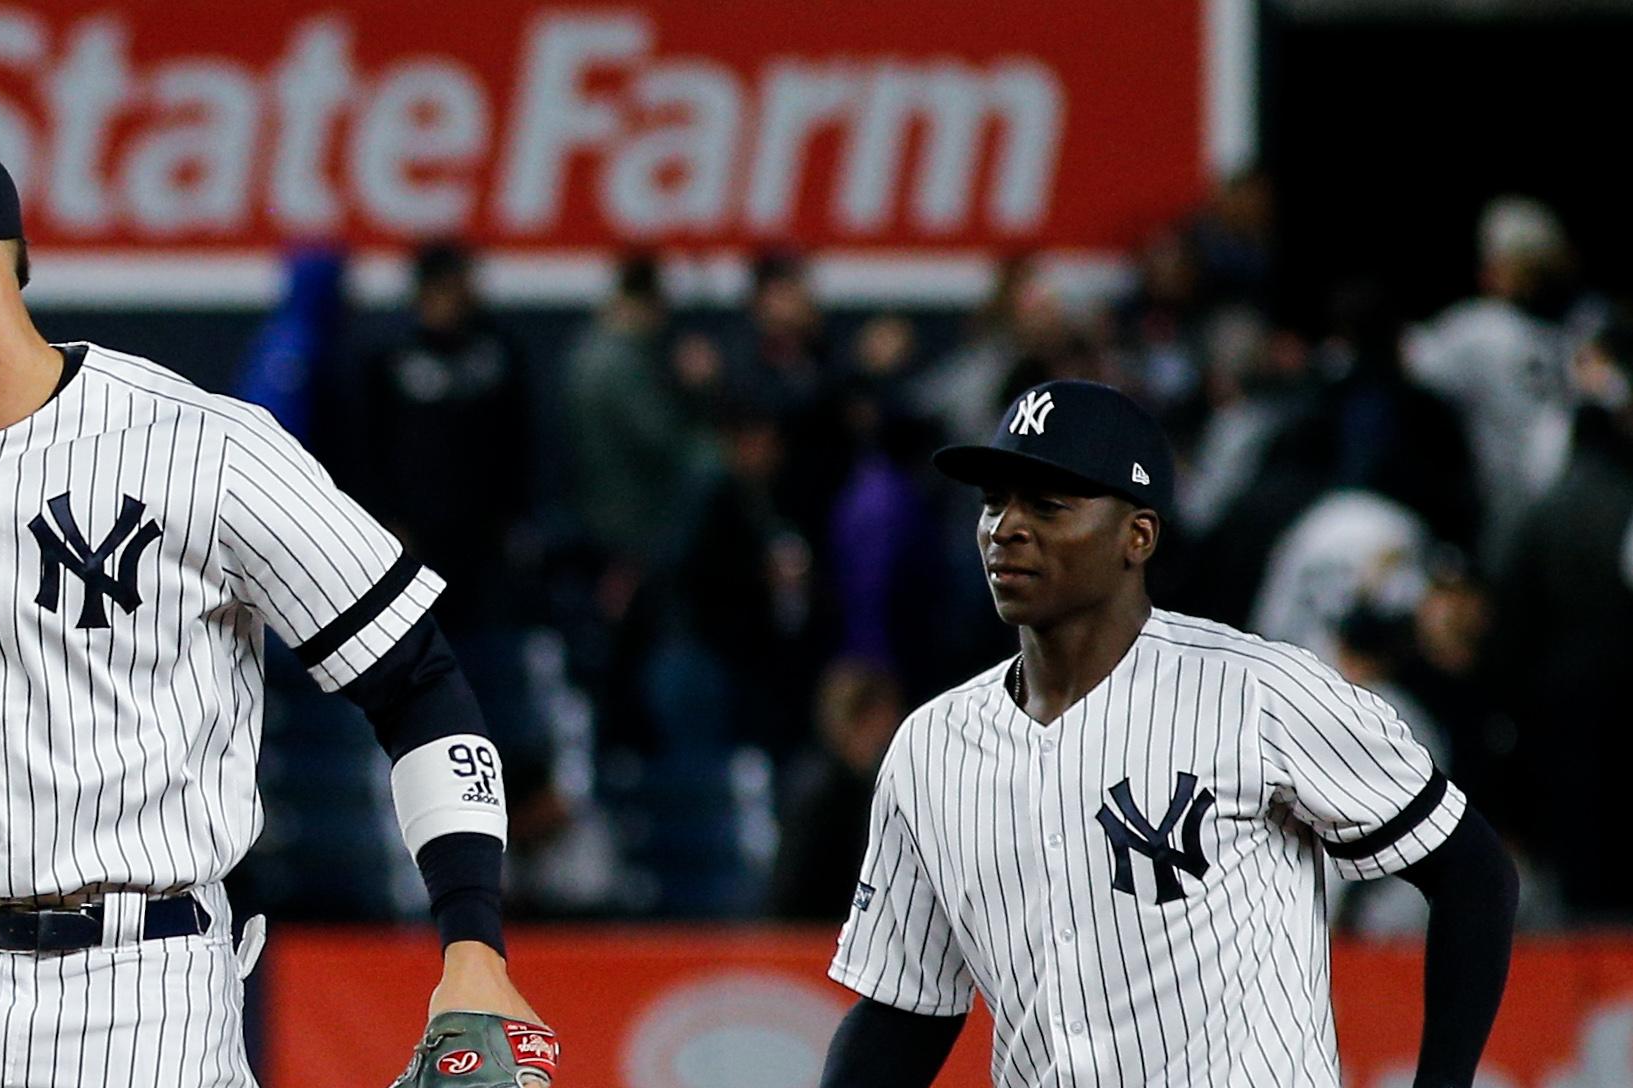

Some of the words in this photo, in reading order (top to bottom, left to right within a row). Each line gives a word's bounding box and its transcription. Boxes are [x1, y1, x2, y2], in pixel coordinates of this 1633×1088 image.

[1009, 390, 1055, 435] NY
[27, 490, 164, 629] NY
[448, 743, 496, 780] 99
[1095, 771, 1216, 905] NY
